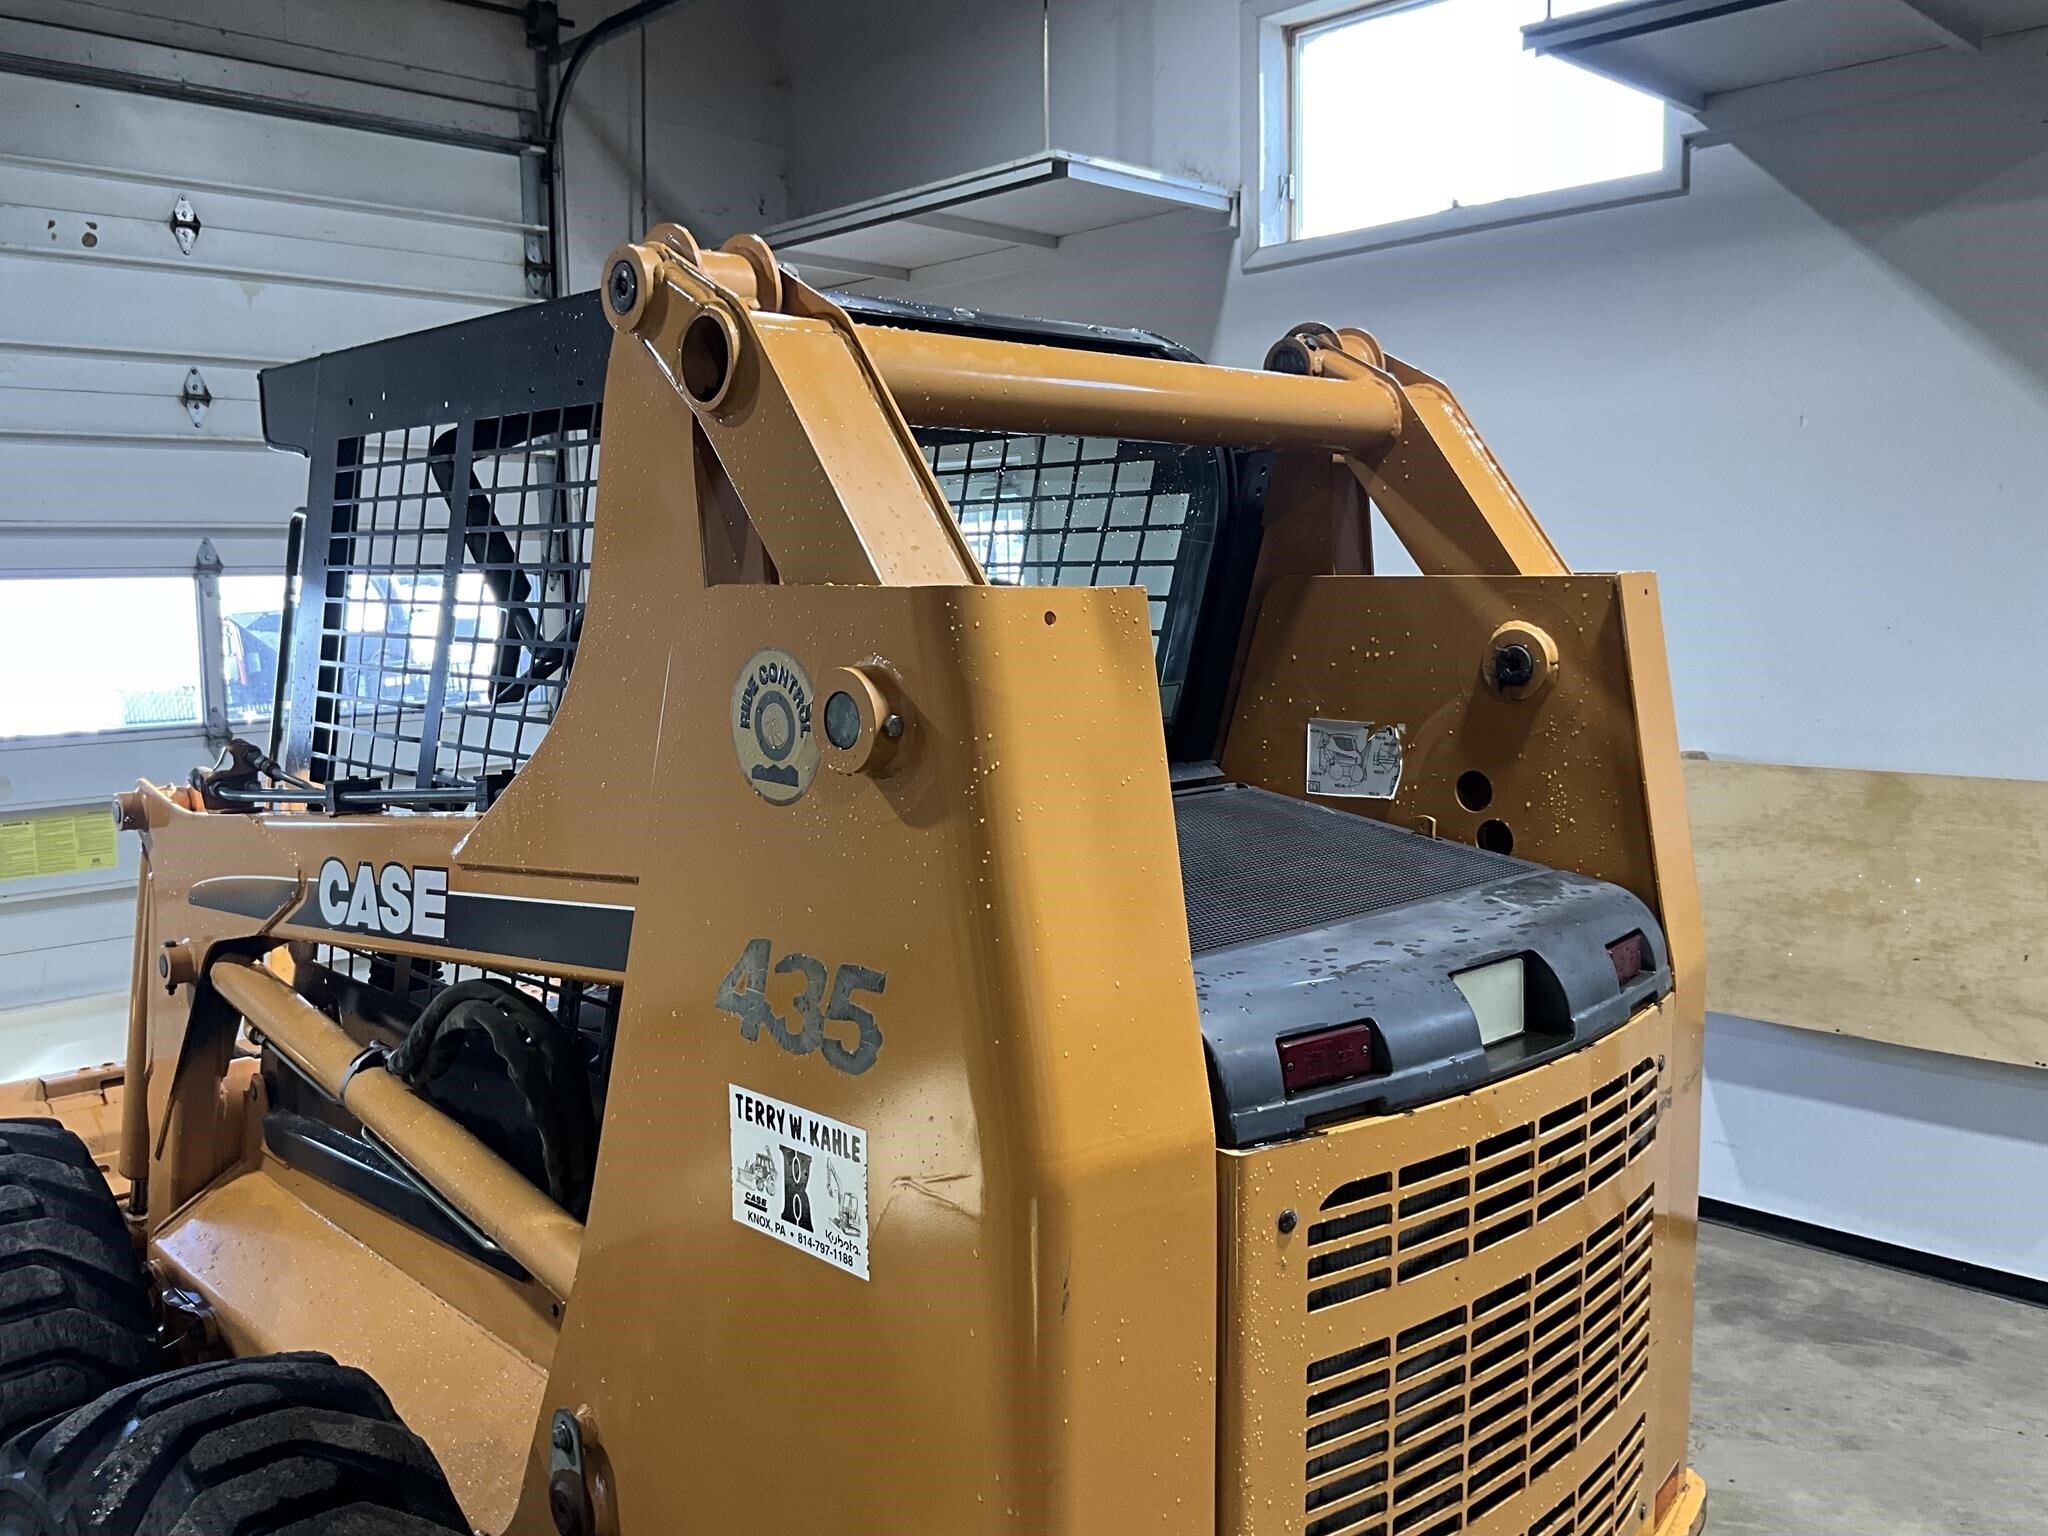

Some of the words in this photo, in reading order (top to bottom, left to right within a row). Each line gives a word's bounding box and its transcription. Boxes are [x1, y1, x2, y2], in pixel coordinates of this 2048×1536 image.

[759, 662, 811, 738] CONTROL
[318, 858, 447, 938] CASE
[716, 938, 887, 1076] 435
[735, 1093, 785, 1135] TERRY
[789, 1113, 806, 1143] W.
[809, 1120, 861, 1163] KAHLE
[745, 1192, 767, 1207] CASE
[747, 1210, 773, 1233] KNOX,
[775, 1221, 786, 1237] PA
[797, 1232, 853, 1267] 814-797-1188
